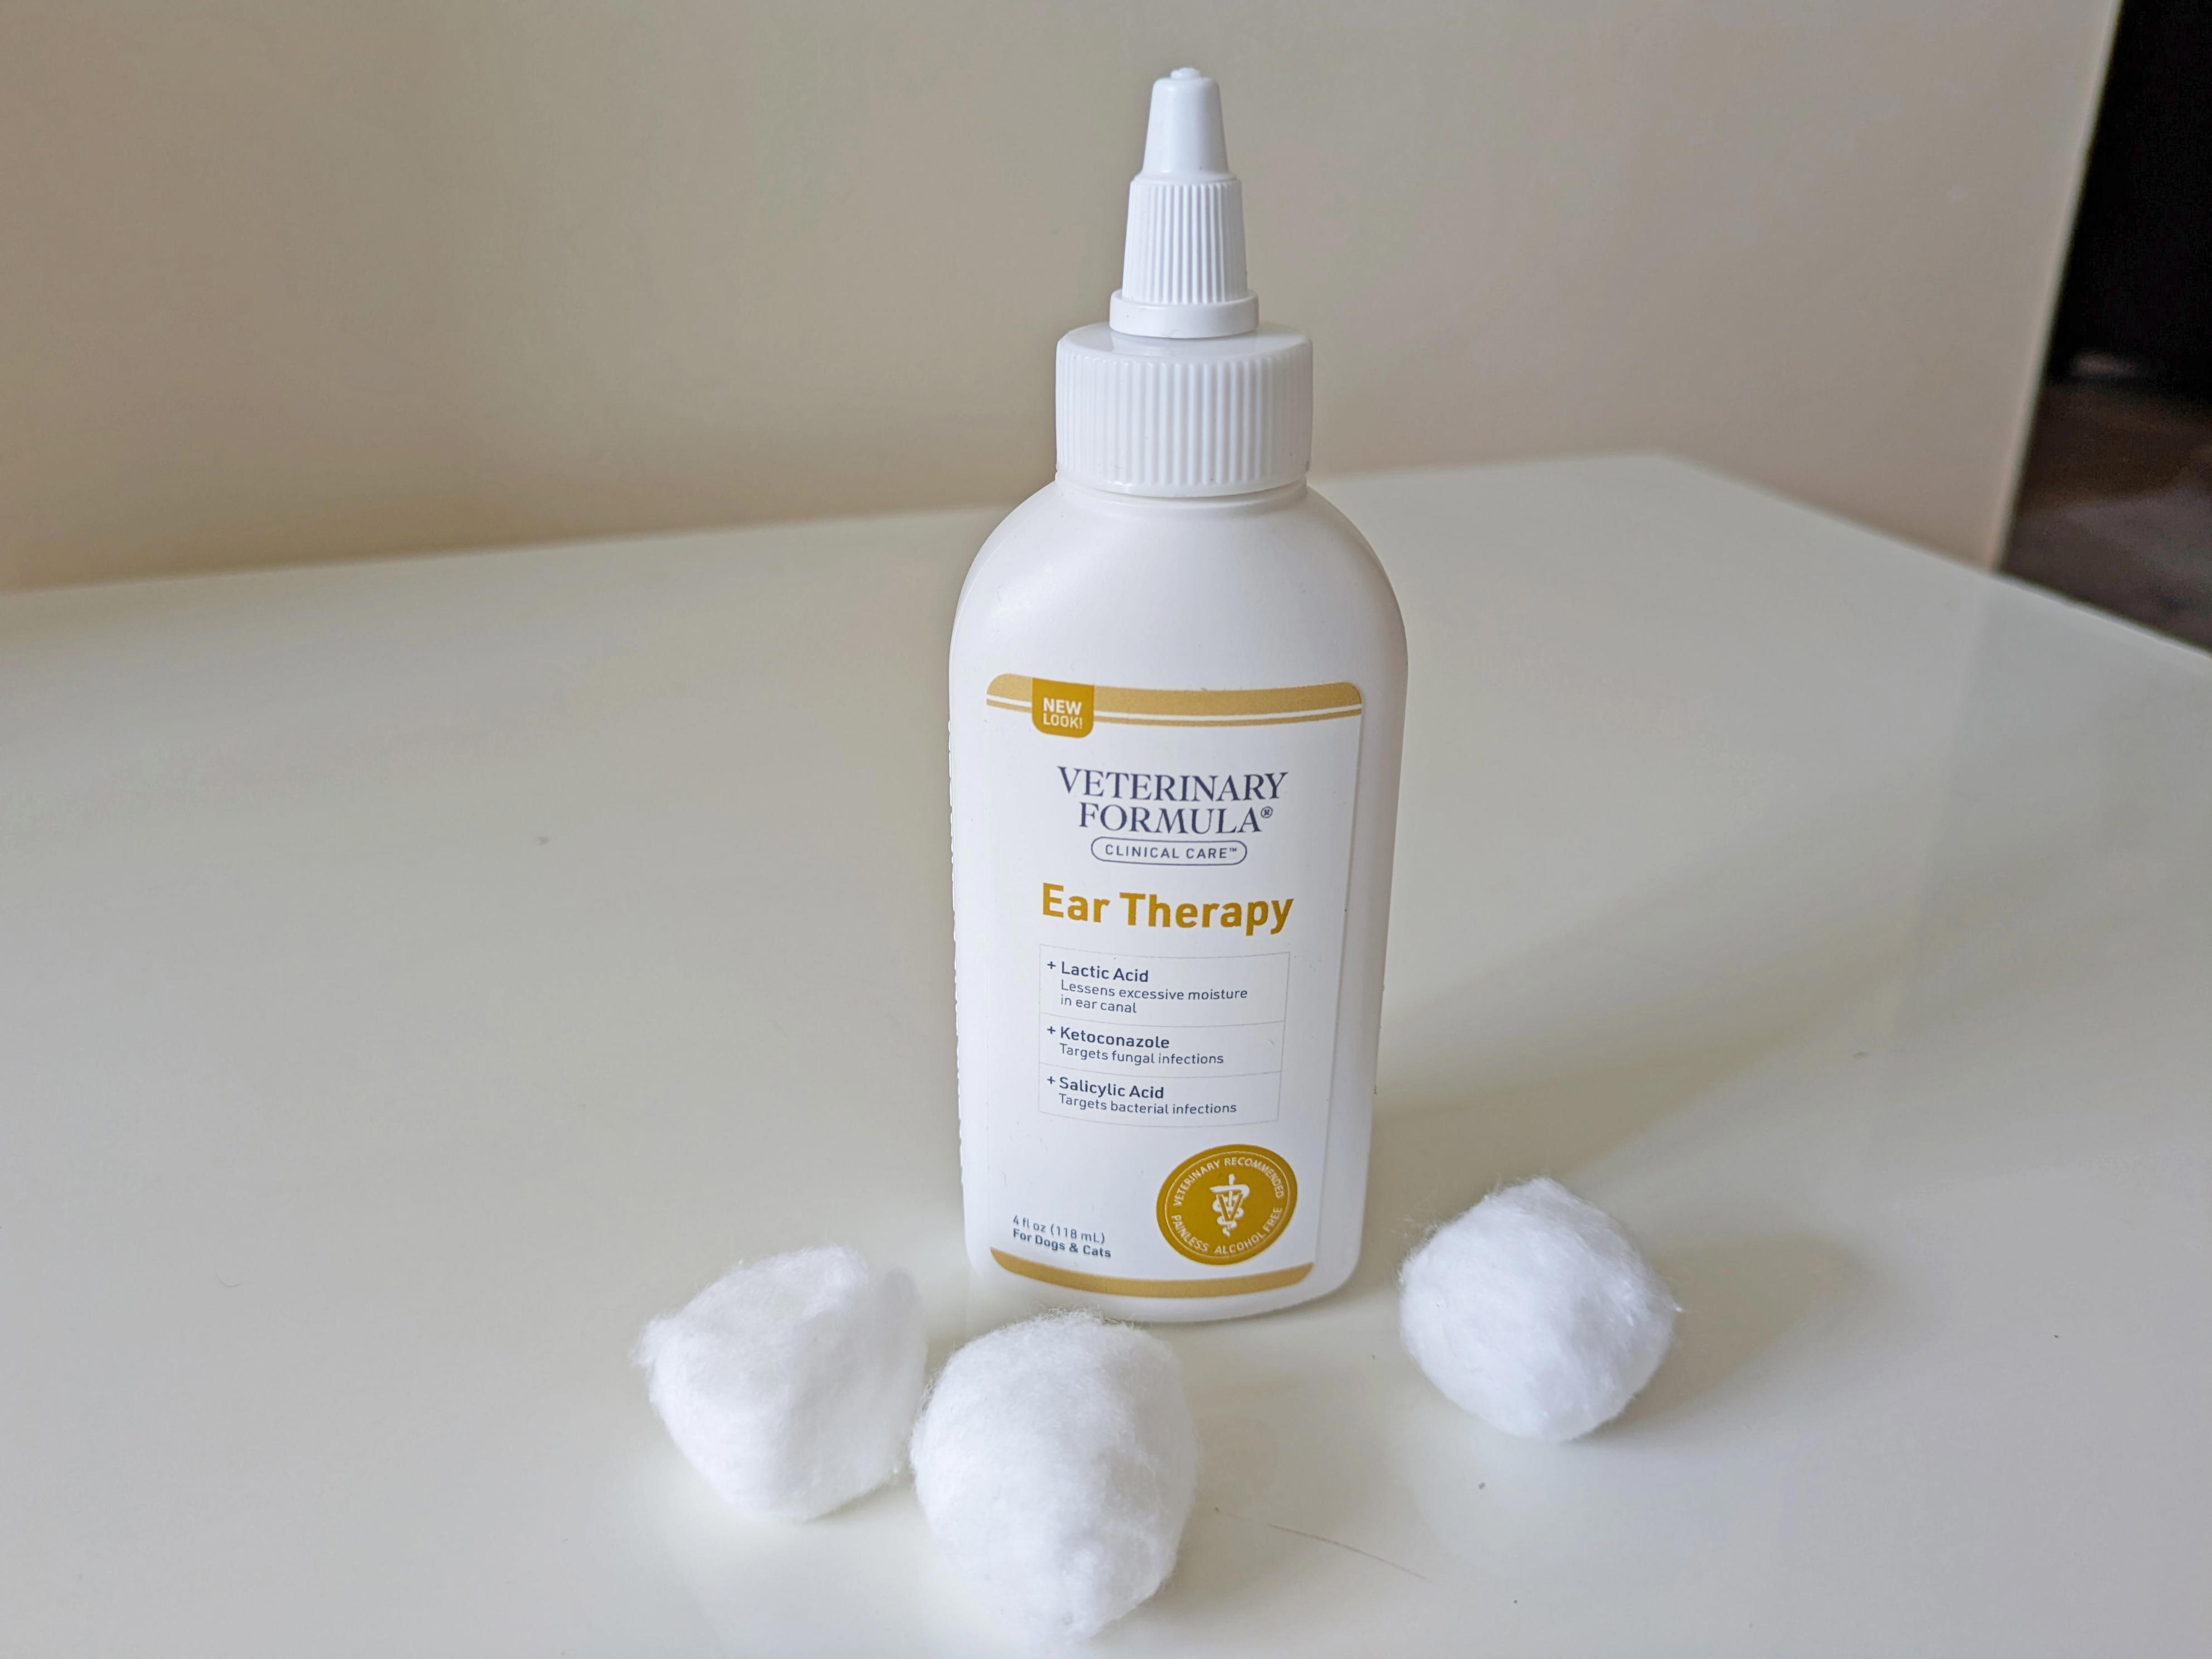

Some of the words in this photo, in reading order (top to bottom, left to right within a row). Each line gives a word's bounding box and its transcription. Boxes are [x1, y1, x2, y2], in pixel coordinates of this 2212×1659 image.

[1043, 697, 1082, 715] NEW
[1043, 713, 1082, 729] LOOK!
[1058, 766, 1288, 802] VETERINARY
[1105, 845, 1180, 859] CLINICAL
[1042, 882, 1110, 923] Ear
[1120, 893, 1294, 935] Therapy
[1061, 961, 1110, 980] Lactic
[1113, 968, 1149, 982] Acid
[1061, 980, 1115, 997] Lessens
[1119, 988, 1184, 1000] excessive
[1188, 988, 1247, 1000] moisture
[1061, 995, 1072, 1006] in
[1076, 999, 1097, 1009] ear
[1100, 1002, 1137, 1013] canal
[1061, 1027, 1170, 1049] Ketoconazole
[1060, 1044, 1109, 1060] Targets
[1112, 1051, 1155, 1065] fungal
[1158, 1053, 1224, 1064] infections
[1059, 1077, 1125, 1098] Salicylic
[1129, 1086, 1164, 1099] Acid
[1059, 1093, 1107, 1111] Targets
[1111, 1101, 1169, 1114] bacterial
[1173, 1103, 1237, 1115] infections
[1173, 1160, 1220, 1207] VETERINARY
[1223, 1157, 1283, 1199] RECOMMENDED
[1013, 1215, 1019, 1226] 4
[1022, 1217, 1030, 1230] fl
[1033, 1223, 1046, 1232] oz
[1050, 1224, 1078, 1239] (118
[1081, 1231, 1105, 1243] mL)
[1172, 1214, 1209, 1253] PAINLESS
[1214, 1231, 1265, 1256] ALCOHOL
[1263, 1207, 1283, 1234] FREE
[1013, 1228, 1032, 1241] For
[1035, 1234, 1066, 1252] Dogs
[1069, 1242, 1078, 1253] &
[1083, 1244, 1111, 1257] Cats
